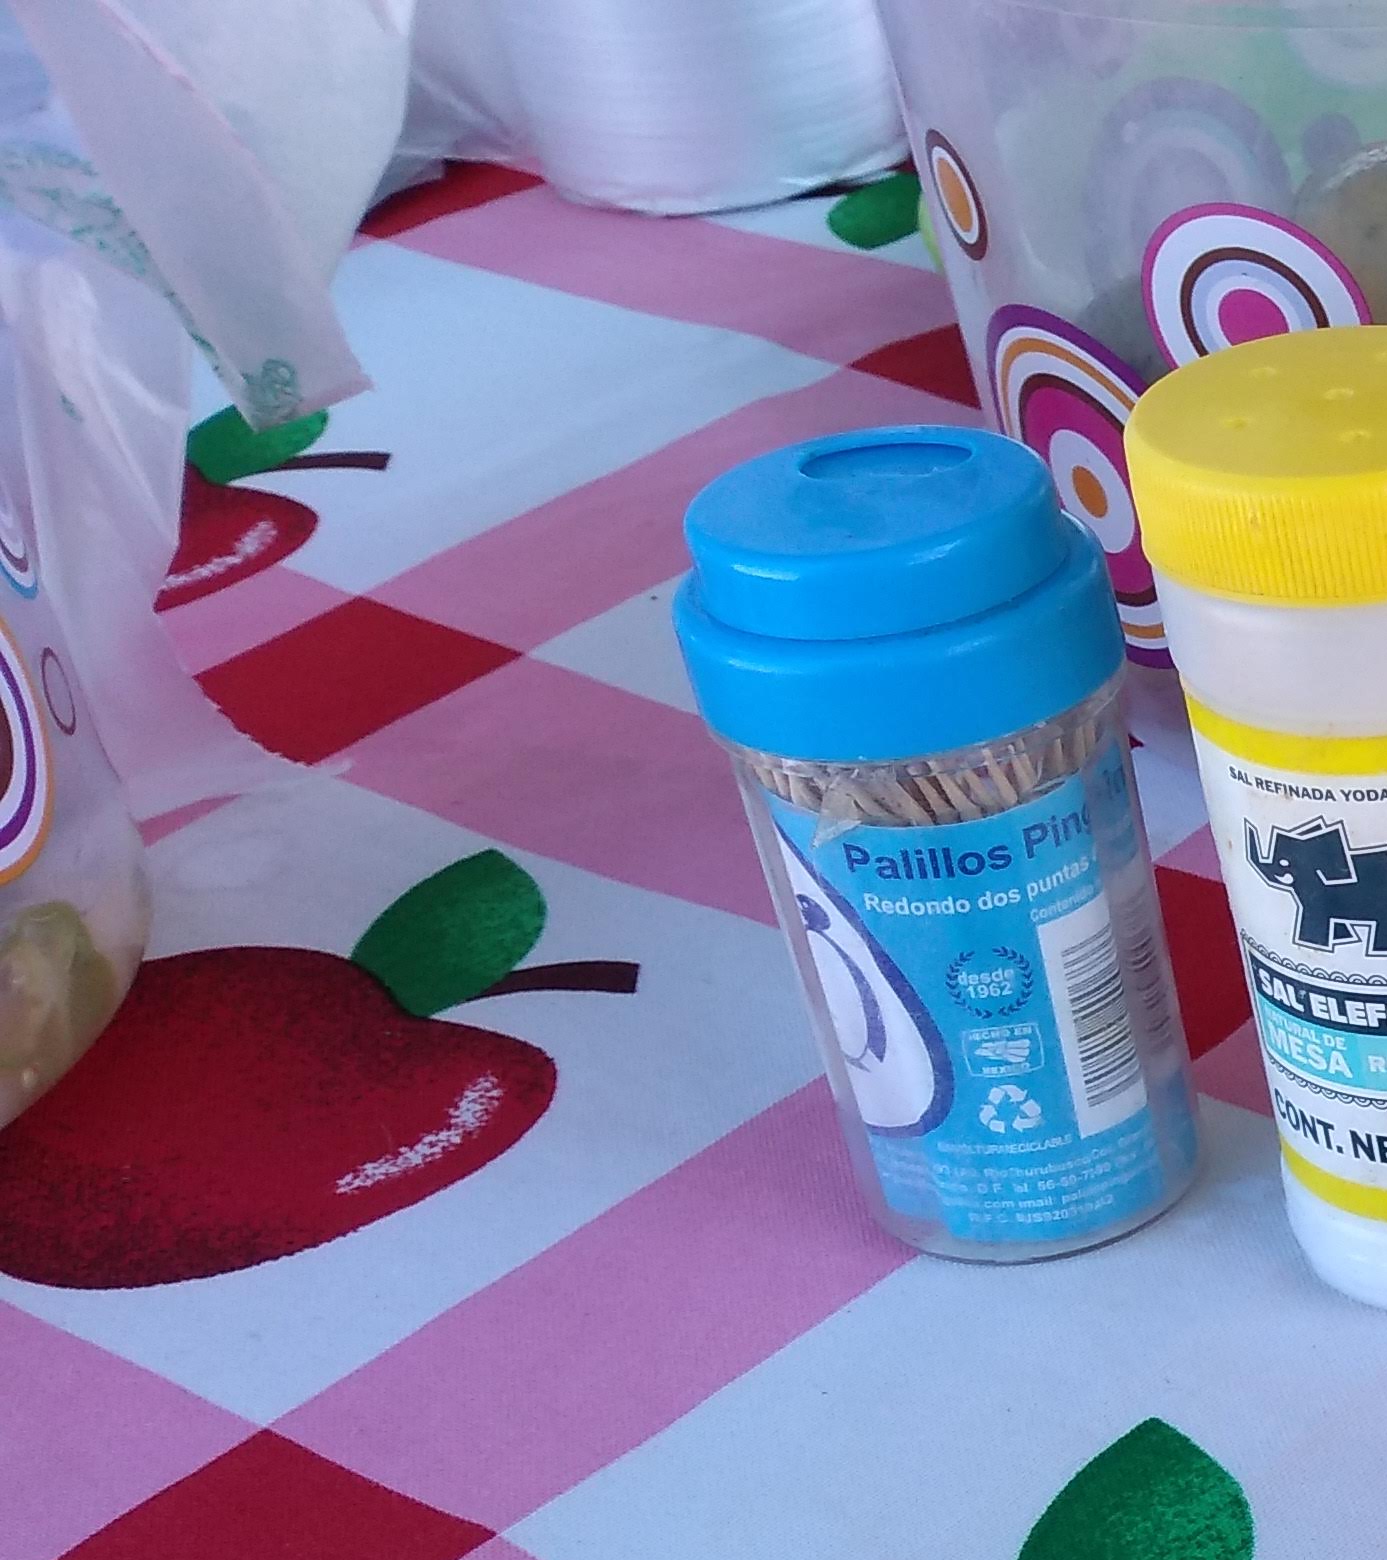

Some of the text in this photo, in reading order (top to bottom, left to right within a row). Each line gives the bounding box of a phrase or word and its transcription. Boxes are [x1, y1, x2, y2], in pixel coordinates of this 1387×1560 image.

[1229, 765, 1253, 786] SAL
[1254, 777, 1337, 802] REFINADA
[842, 842, 1013, 880] Palillos
[863, 857, 1091, 916] Redondo dos puntas
[957, 967, 1015, 985] desde
[966, 981, 1014, 999] 1962
[1259, 967, 1305, 1012] SAL
[1267, 1019, 1354, 1079] MESA
[1322, 1033, 1347, 1050] DE
[1274, 1088, 1344, 1154] CONT.
